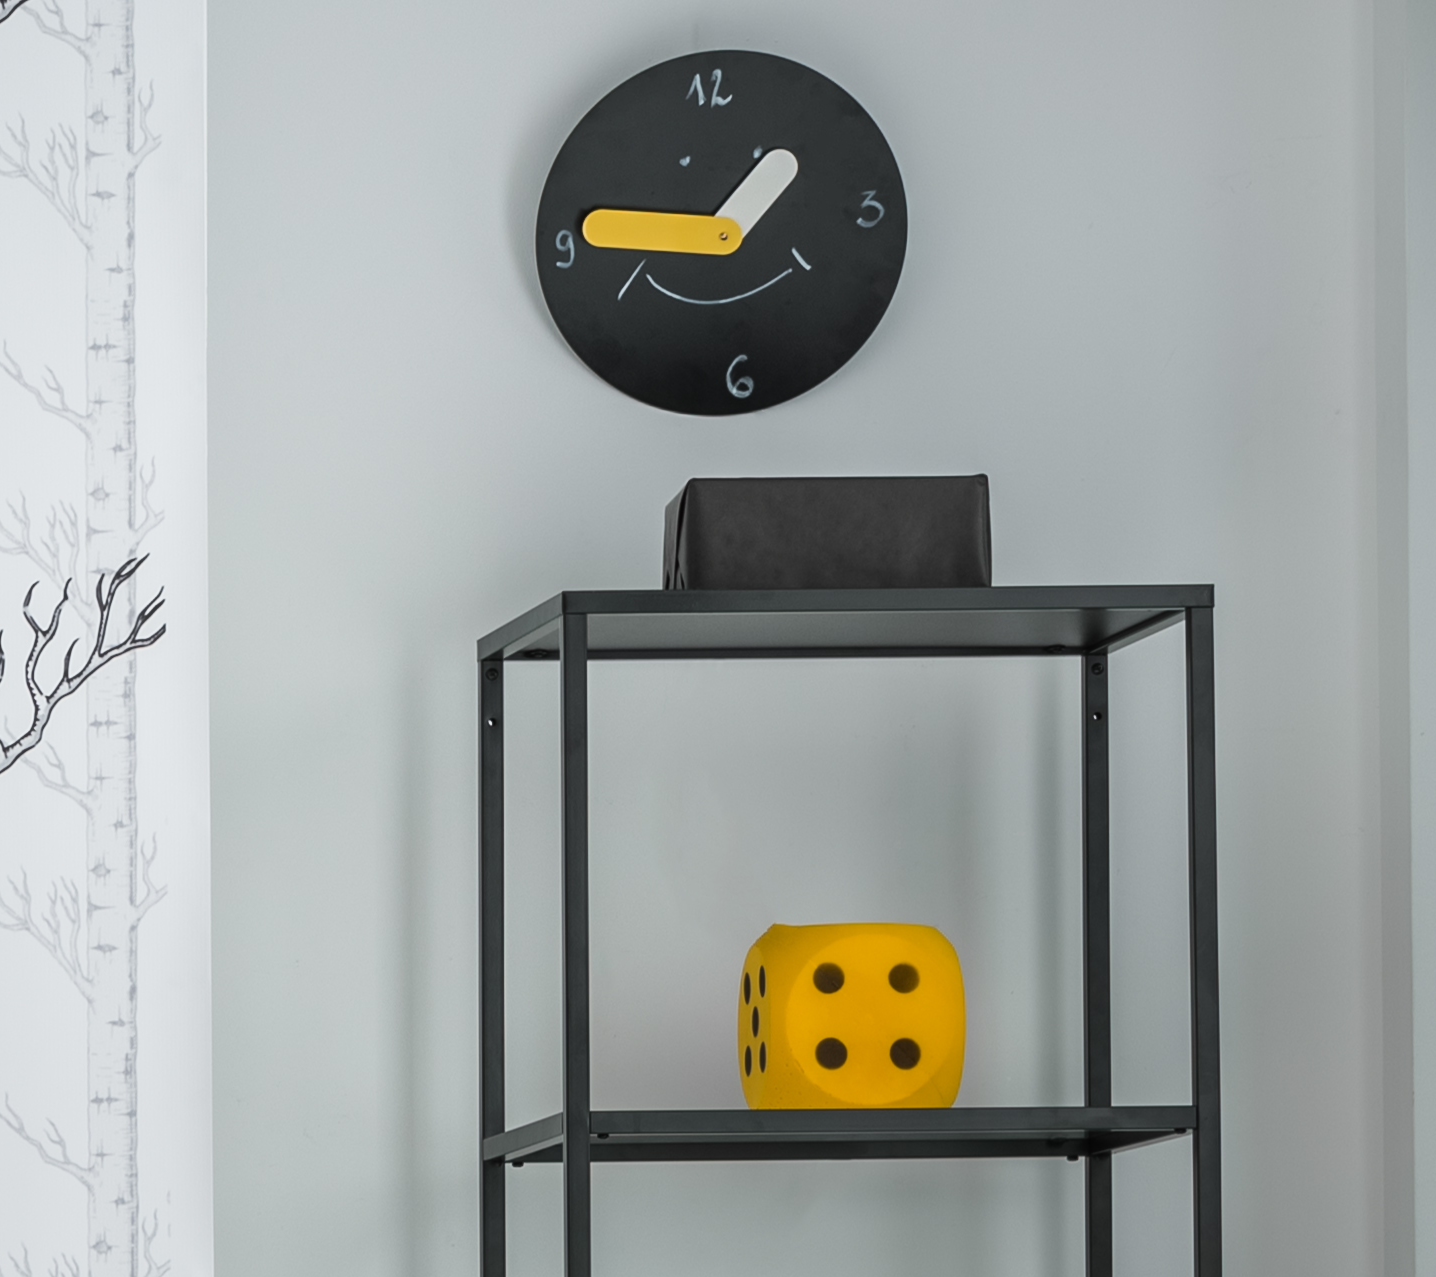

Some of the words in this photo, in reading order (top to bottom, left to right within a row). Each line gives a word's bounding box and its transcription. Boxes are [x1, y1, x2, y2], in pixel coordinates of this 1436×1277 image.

[686, 68, 733, 108] 12
[856, 190, 885, 228] 3
[555, 229, 575, 268] 9
[726, 354, 754, 398] 6
